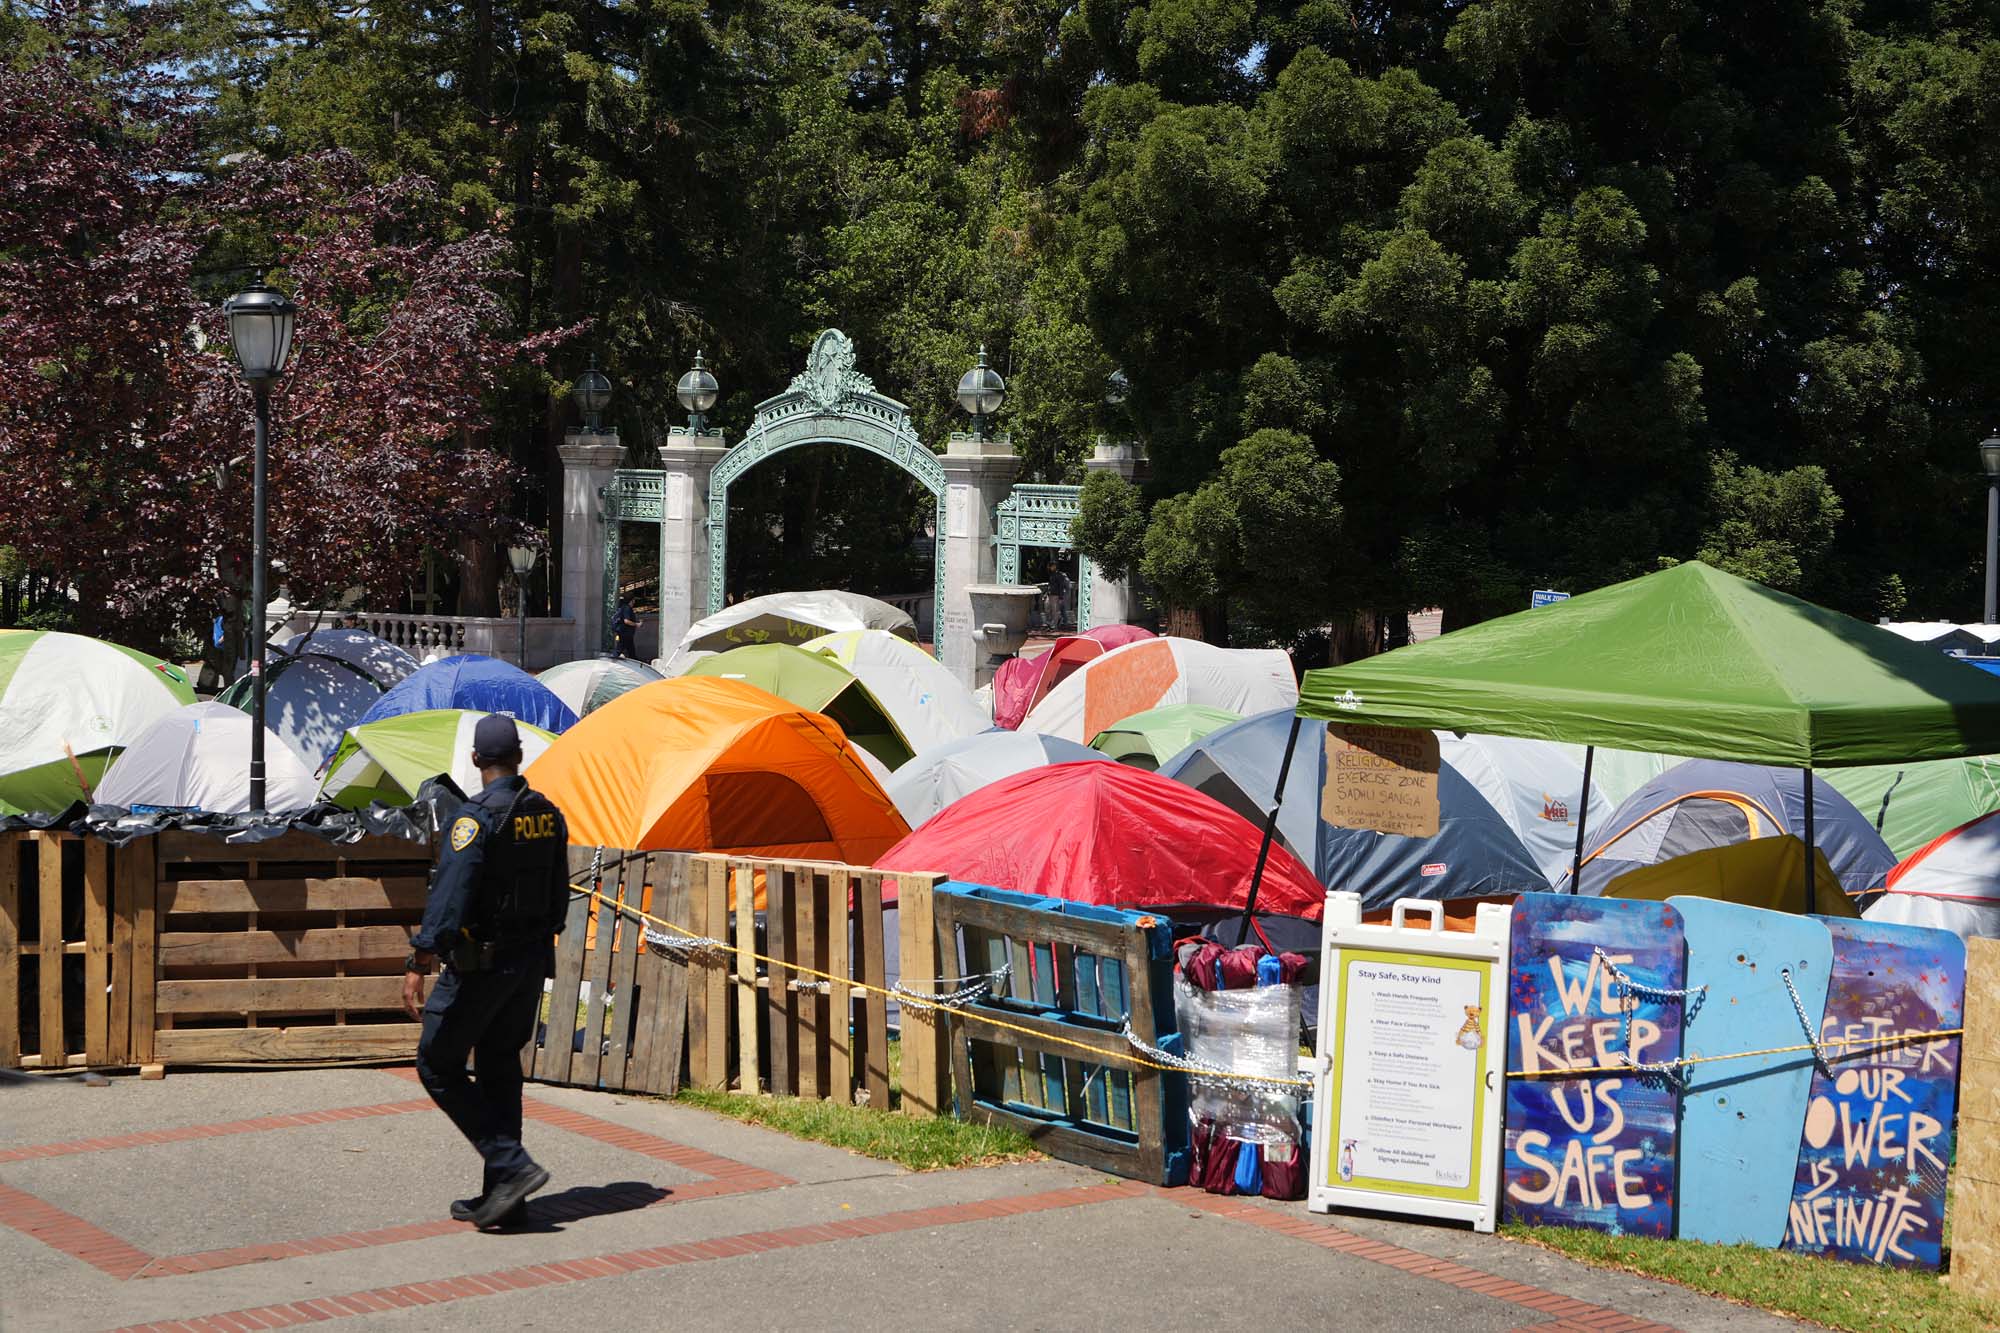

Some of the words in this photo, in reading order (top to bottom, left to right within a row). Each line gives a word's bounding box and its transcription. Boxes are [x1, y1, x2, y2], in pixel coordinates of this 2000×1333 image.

[1337, 771, 1392, 785] EXERCISE
[1399, 776, 1427, 788] ZONE
[514, 813, 557, 841] POLICE
[1552, 807, 1568, 817] REI
[1358, 969, 1377, 980] Stay
[1378, 971, 1400, 981] Safe,
[1401, 973, 1420, 984] Stay
[1422, 975, 1441, 984] Kind
[1548, 954, 1640, 1016] WE
[1518, 1013, 1661, 1082] KEEP
[1836, 1069, 1914, 1104] OUR
[1551, 1079, 1624, 1143] US
[1804, 1096, 1946, 1172] OWER
[1508, 1130, 1652, 1211] SAFE
[1804, 1158, 1839, 1201] IS
